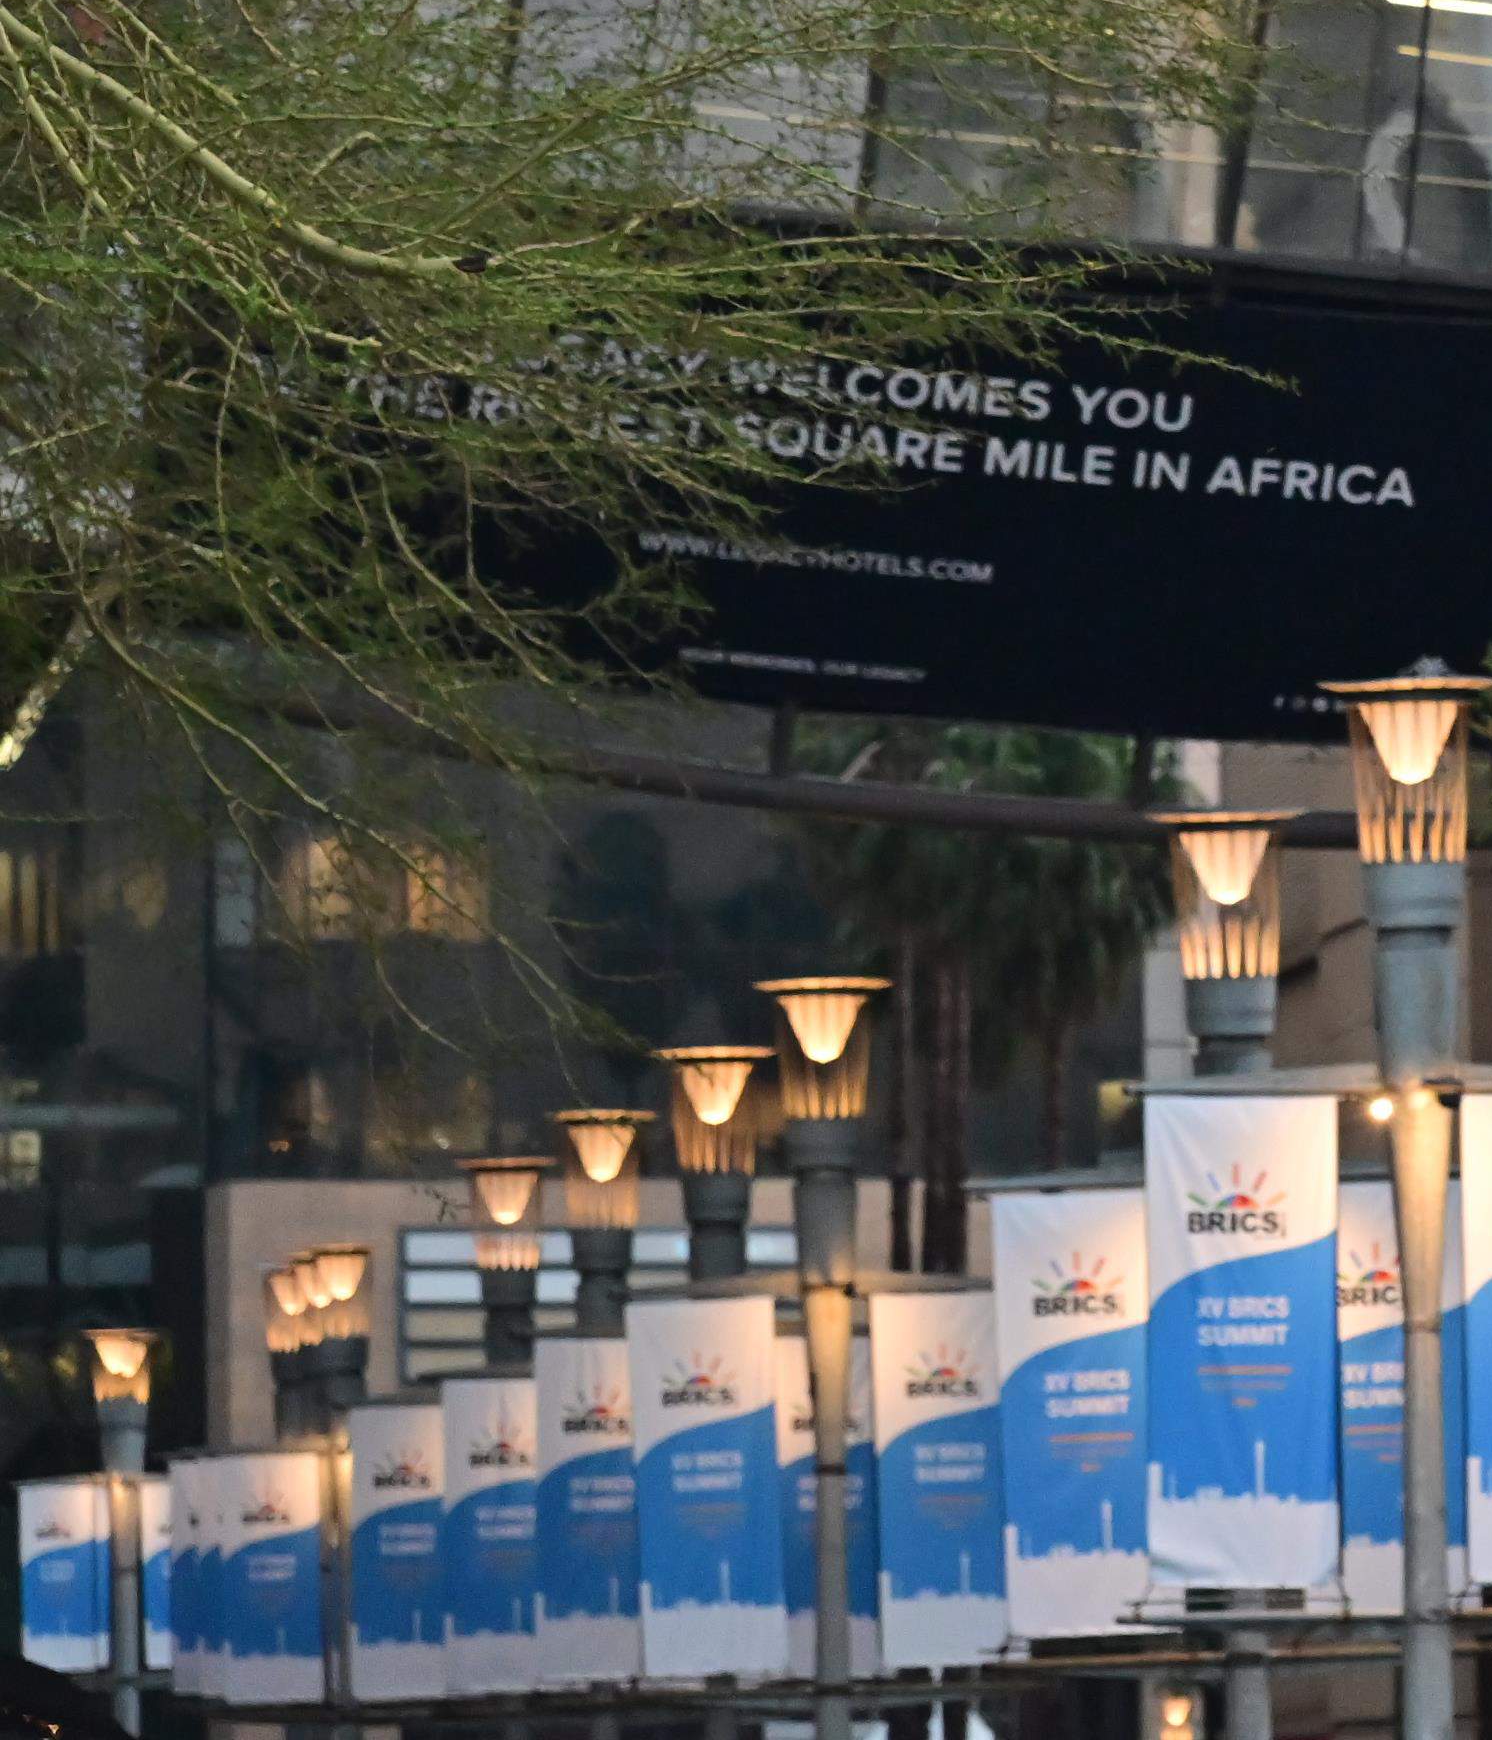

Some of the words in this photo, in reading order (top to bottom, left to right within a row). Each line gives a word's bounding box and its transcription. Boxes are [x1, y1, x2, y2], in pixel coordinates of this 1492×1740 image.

[1071, 383, 1195, 433] YOU
[983, 434, 1116, 487] MILE
[1131, 448, 1192, 493] IN
[1205, 455, 1416, 509] AFRICA
[1187, 1209, 1279, 1235] BRICS
[1033, 1293, 1119, 1318] BRICS
